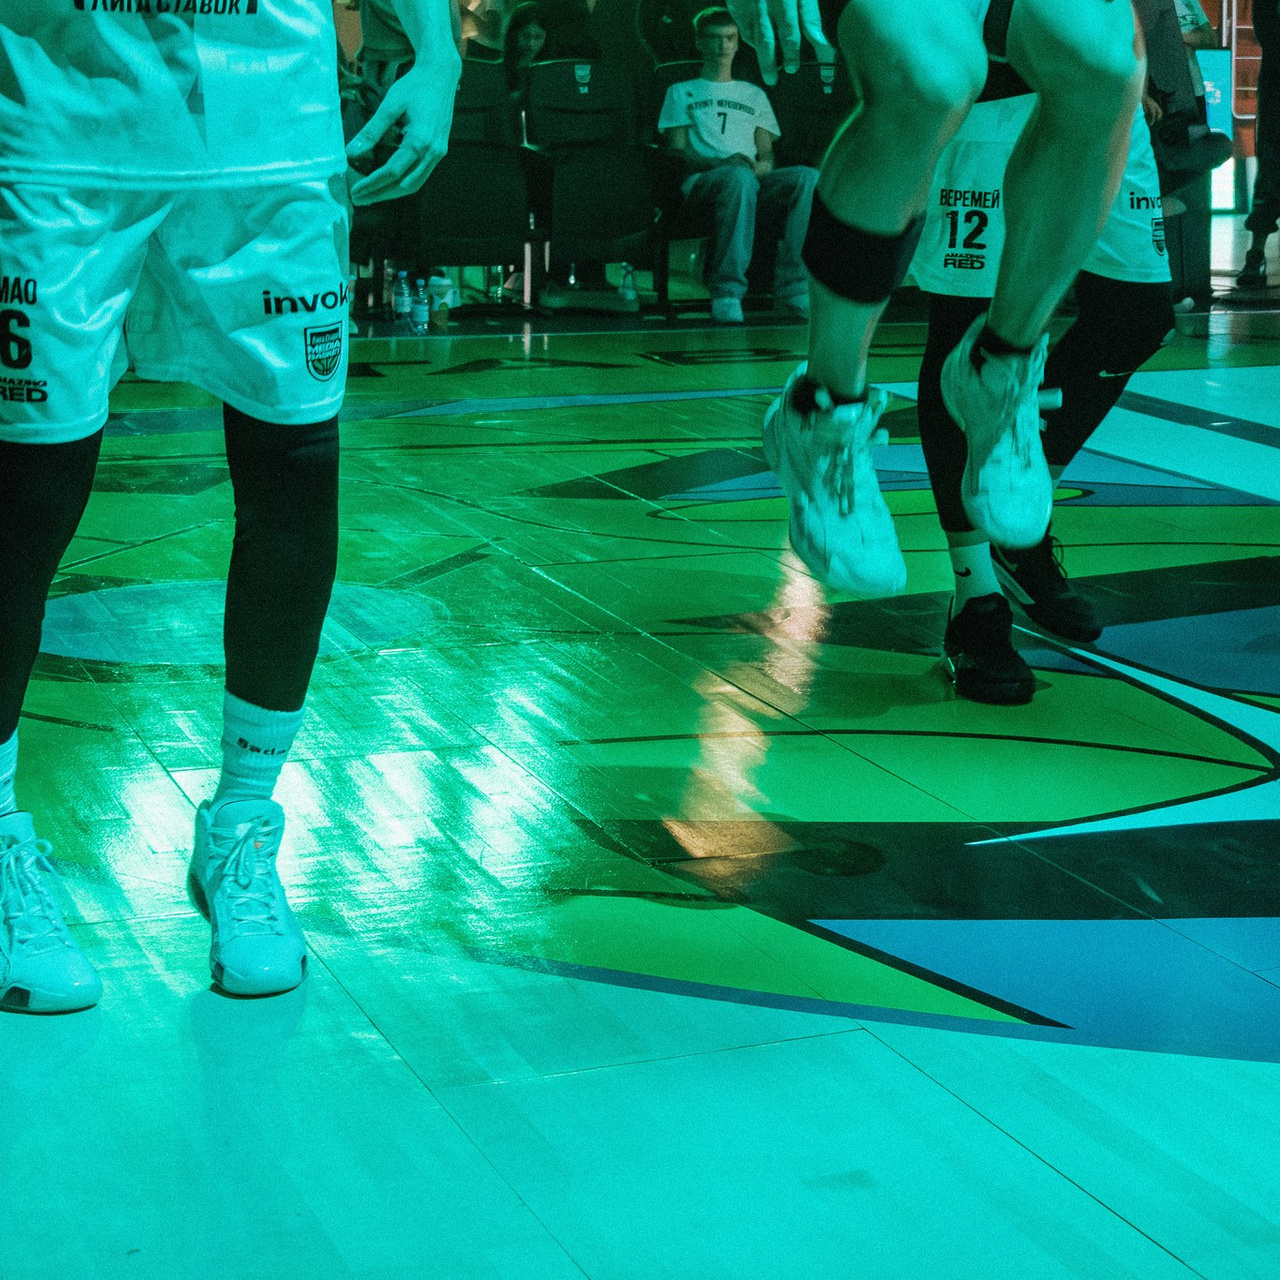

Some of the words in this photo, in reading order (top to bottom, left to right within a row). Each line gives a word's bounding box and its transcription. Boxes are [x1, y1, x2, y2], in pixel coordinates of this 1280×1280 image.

[716, 111, 728, 136] 7
[939, 188, 1001, 209] ВЕРЕМЕЙ
[945, 209, 989, 250] 12
[943, 258, 986, 271] RED
[262, 282, 349, 315] invok
[0, 308, 33, 371] 6
